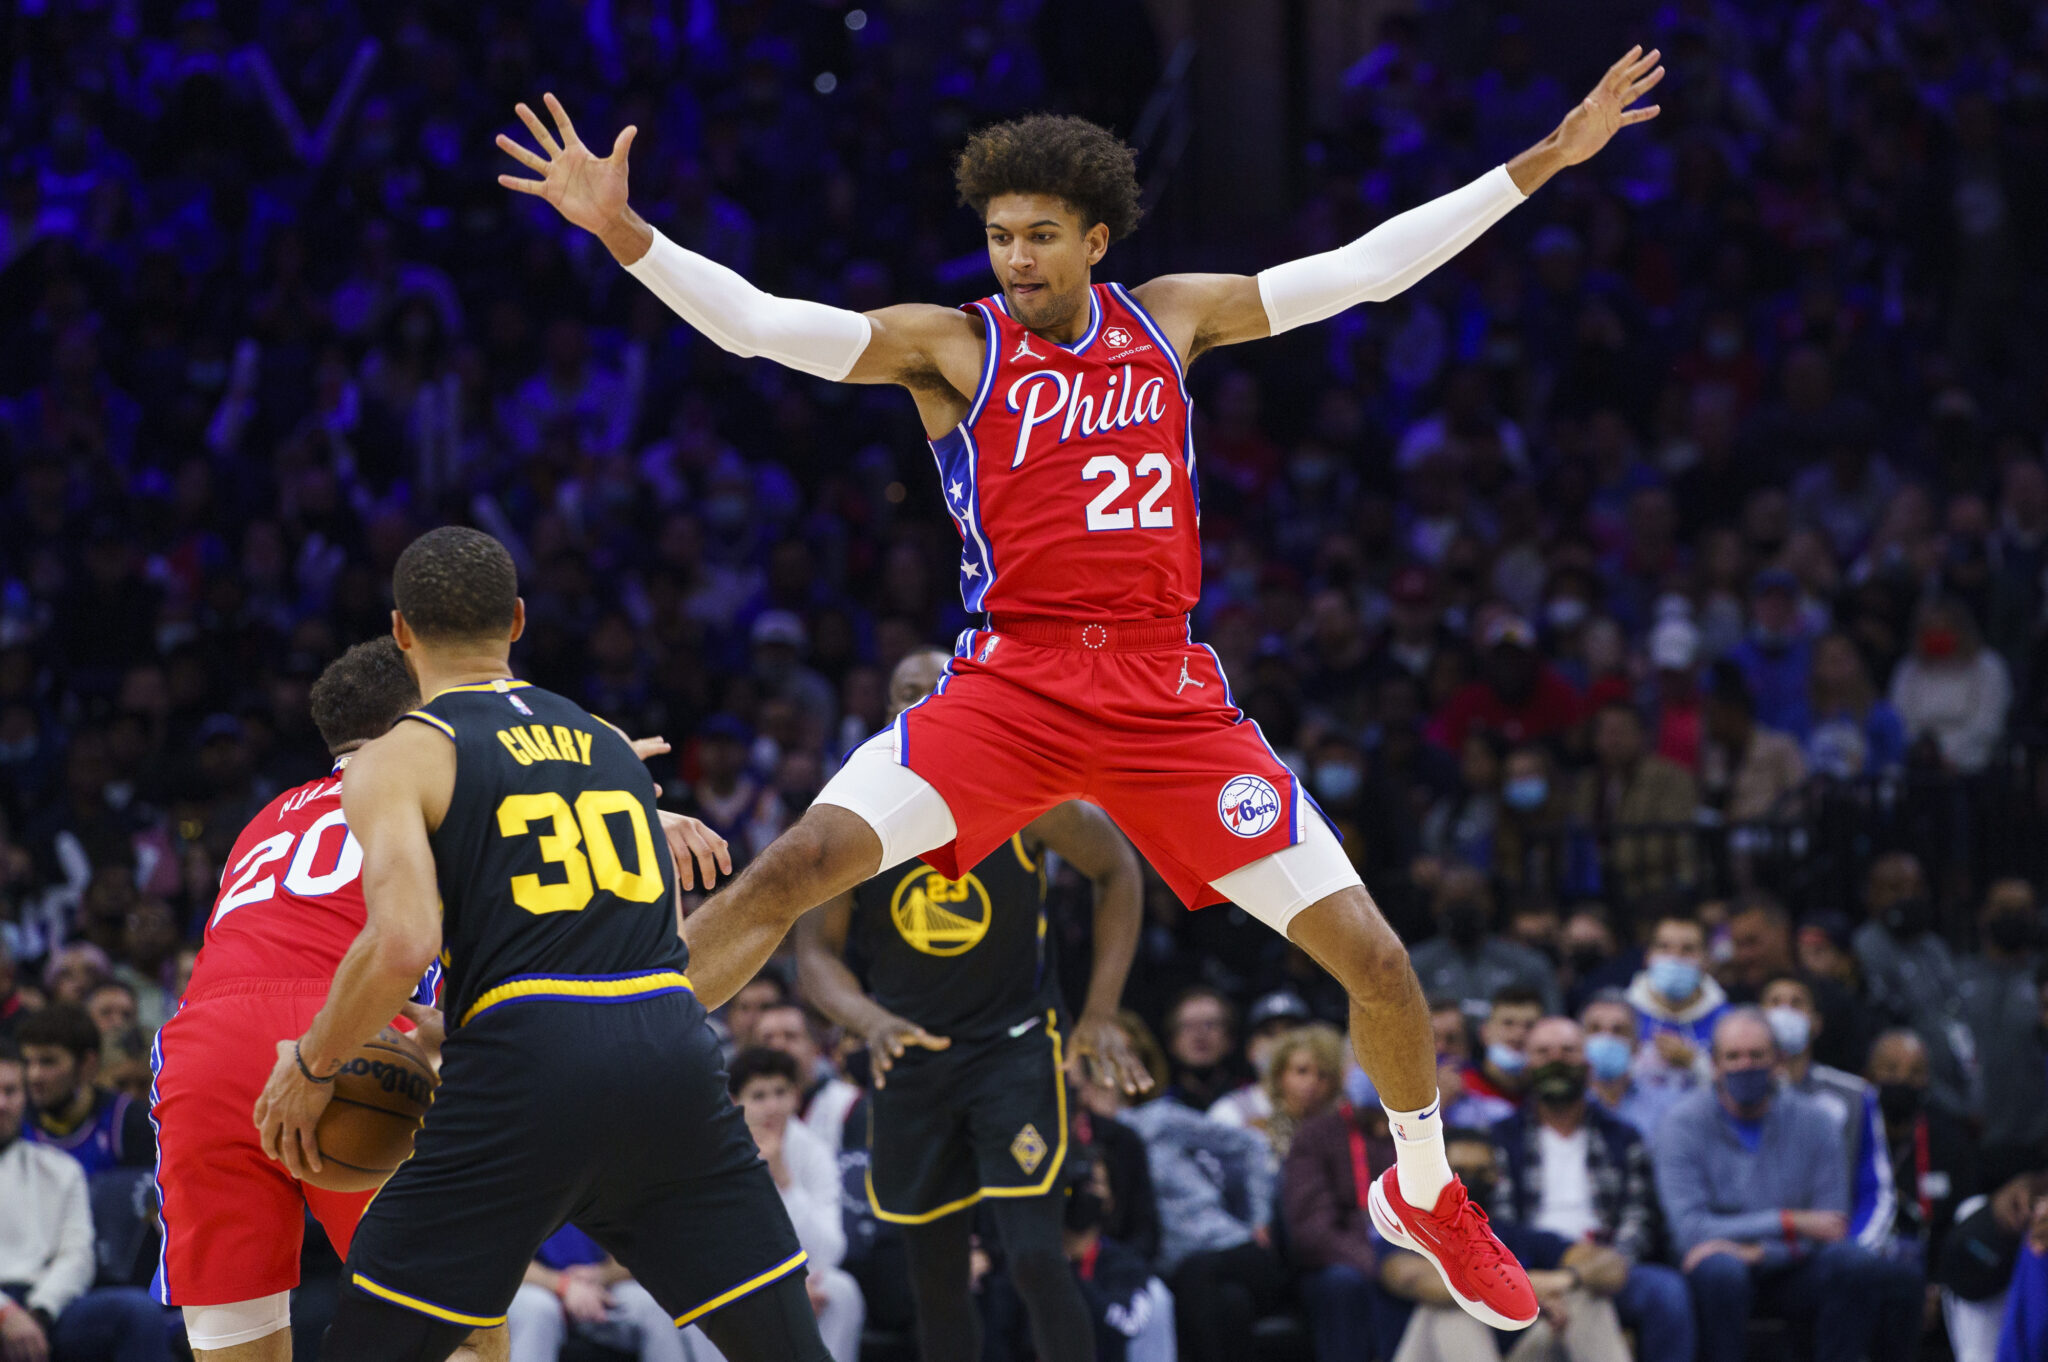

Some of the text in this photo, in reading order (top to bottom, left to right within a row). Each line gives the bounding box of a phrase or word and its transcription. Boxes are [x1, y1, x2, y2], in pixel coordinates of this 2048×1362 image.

[1006, 363, 1166, 470] Phila
[1081, 453, 1173, 531] 22
[496, 724, 592, 766] CURRY
[497, 790, 665, 915] 30
[1225, 799, 1276, 828] 76ers
[211, 808, 364, 930] 20
